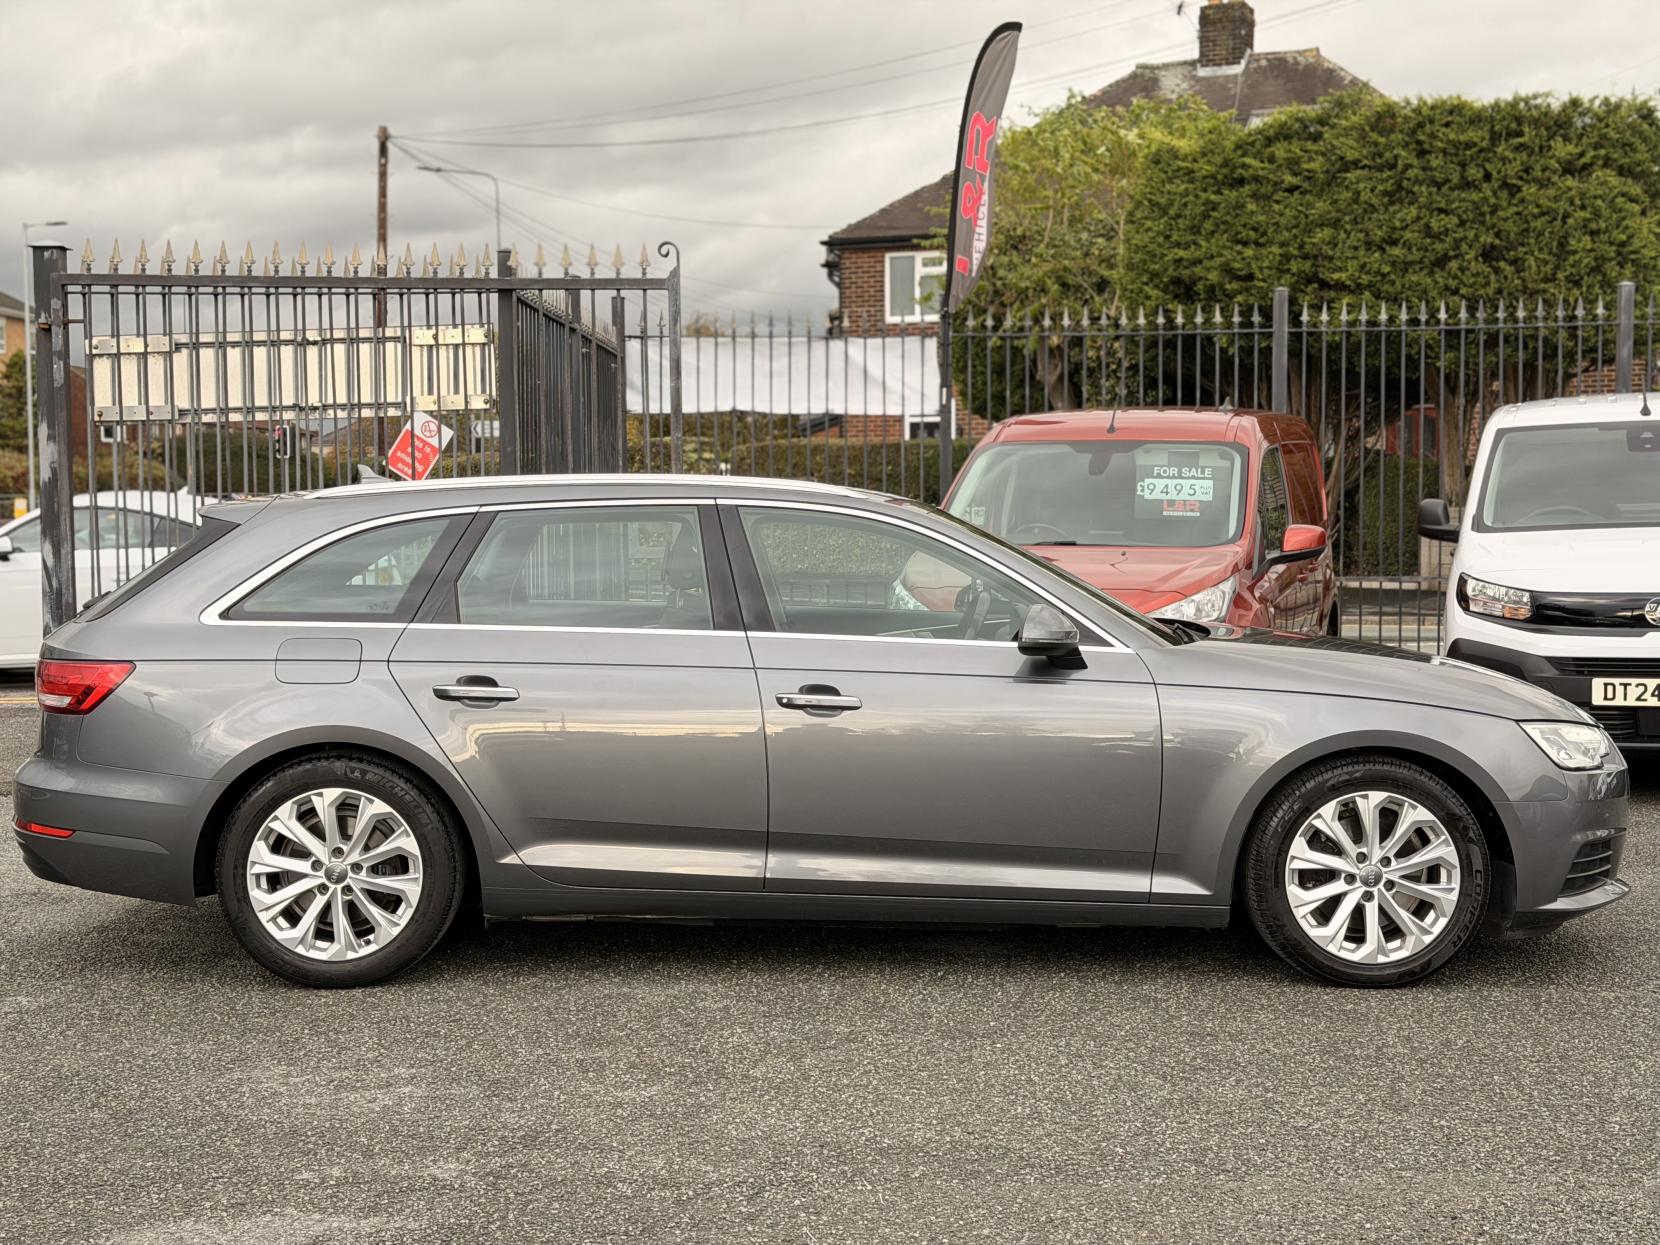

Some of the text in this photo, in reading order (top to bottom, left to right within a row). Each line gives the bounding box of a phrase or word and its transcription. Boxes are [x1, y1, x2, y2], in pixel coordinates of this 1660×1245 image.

[965, 111, 996, 176] R
[1153, 466, 1213, 478] FOR SALE
[1136, 482, 1197, 497] £9495
[1602, 682, 1660, 702] DT24
